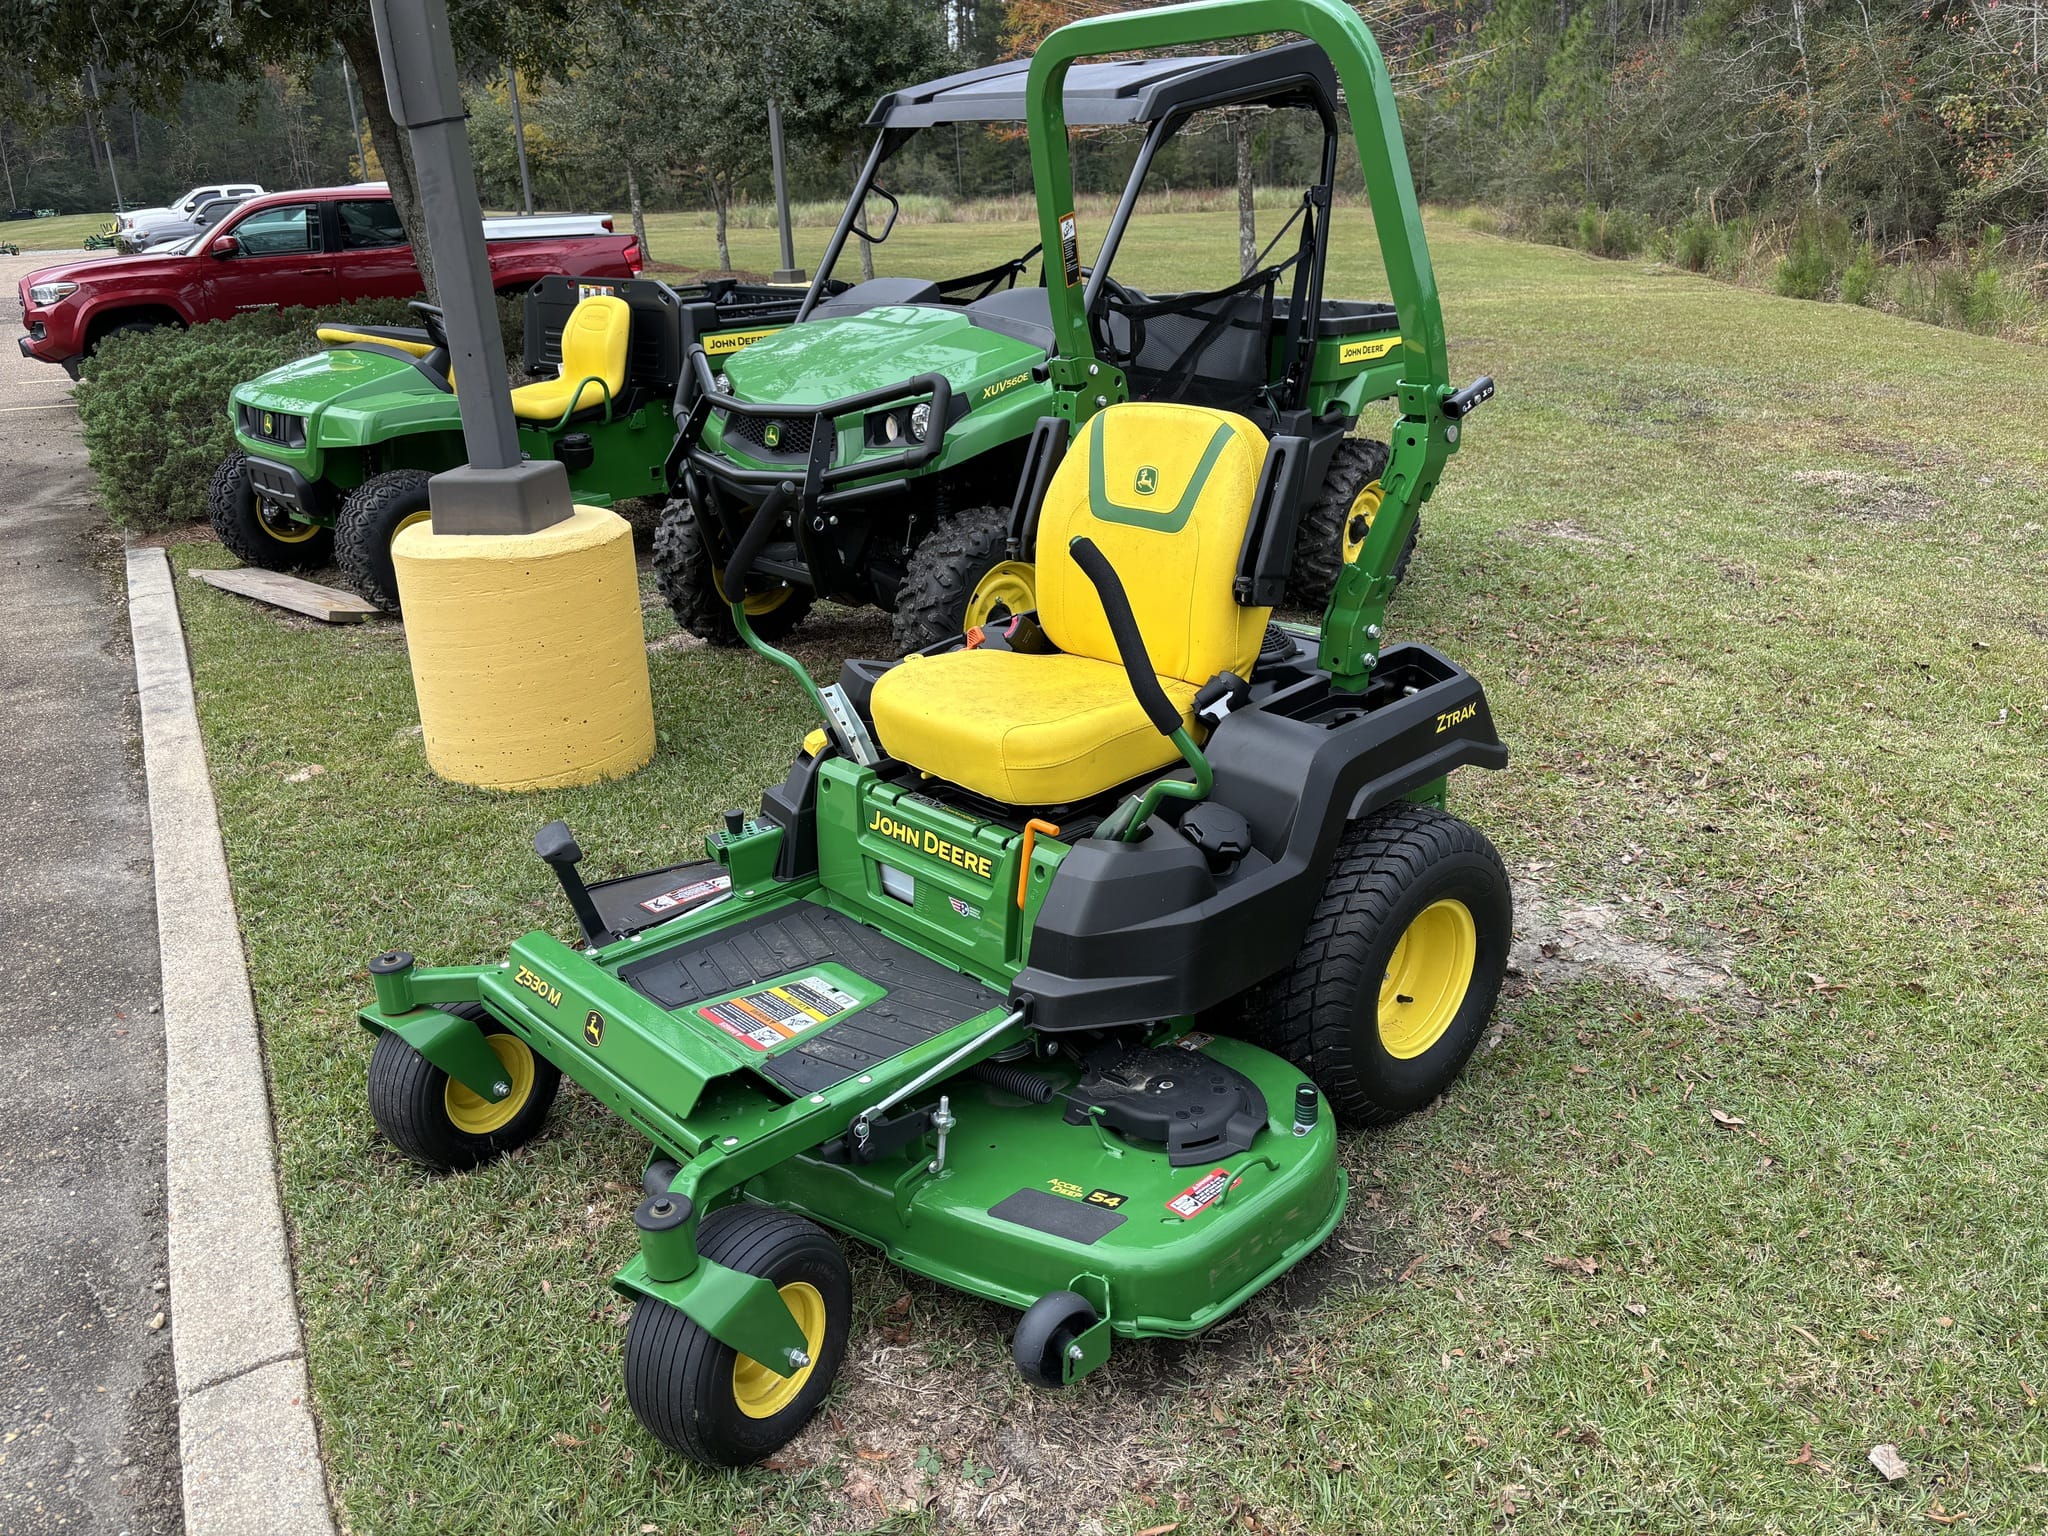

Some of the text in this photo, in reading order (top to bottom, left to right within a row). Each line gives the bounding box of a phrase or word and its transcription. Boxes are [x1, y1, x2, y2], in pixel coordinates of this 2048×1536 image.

[710, 339, 736, 349] JOHN
[1344, 344, 1384, 358] JOHN DEERE
[982, 372, 1029, 400] XUV560E
[1436, 702, 1477, 733] ZTRAK
[869, 810, 993, 879] JOHN DEERE
[514, 965, 562, 1007] Z530 M
[1047, 1178, 1083, 1193] ACCEL
[1050, 1185, 1083, 1199] DEEP
[1088, 1191, 1121, 1208] 54
